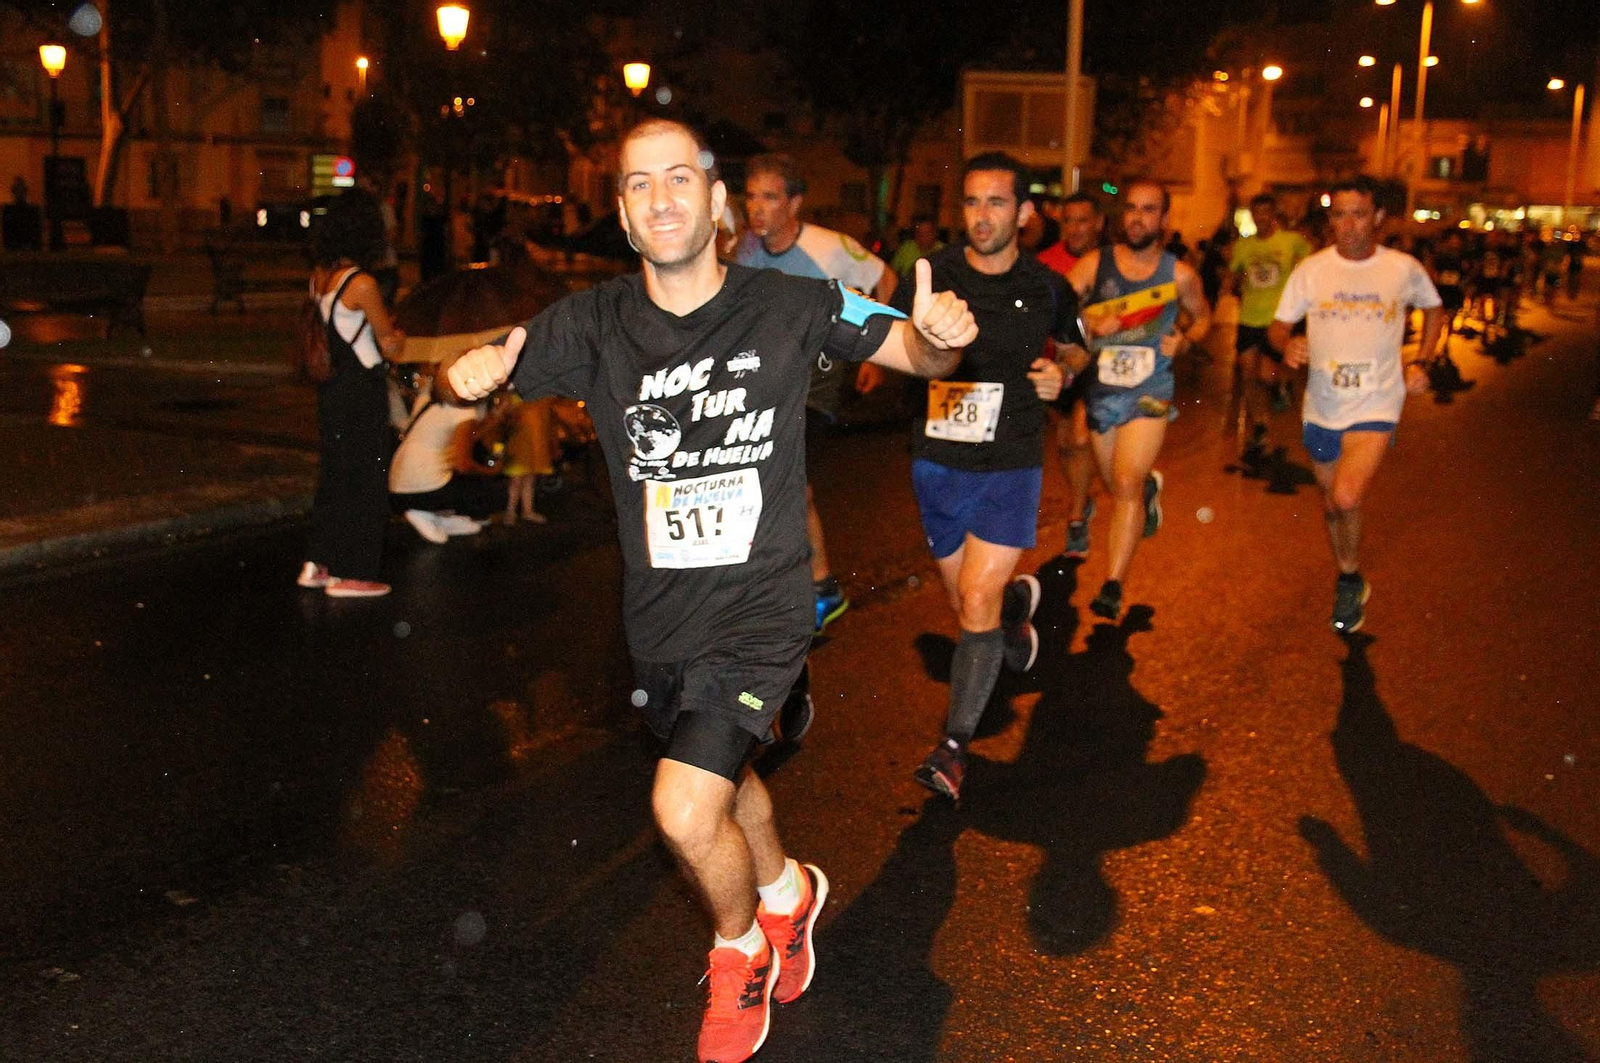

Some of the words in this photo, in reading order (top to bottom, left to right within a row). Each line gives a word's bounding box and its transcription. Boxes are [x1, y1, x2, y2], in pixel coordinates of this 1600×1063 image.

[639, 356, 715, 401] NOC
[691, 387, 747, 422] TUR
[940, 401, 978, 422] 128
[724, 406, 776, 445] NA
[671, 451, 701, 468] DE
[702, 439, 774, 467] HUELVA
[671, 496, 689, 509] DE
[694, 488, 743, 506] HUELVA
[673, 475, 744, 497] NOCTURNA
